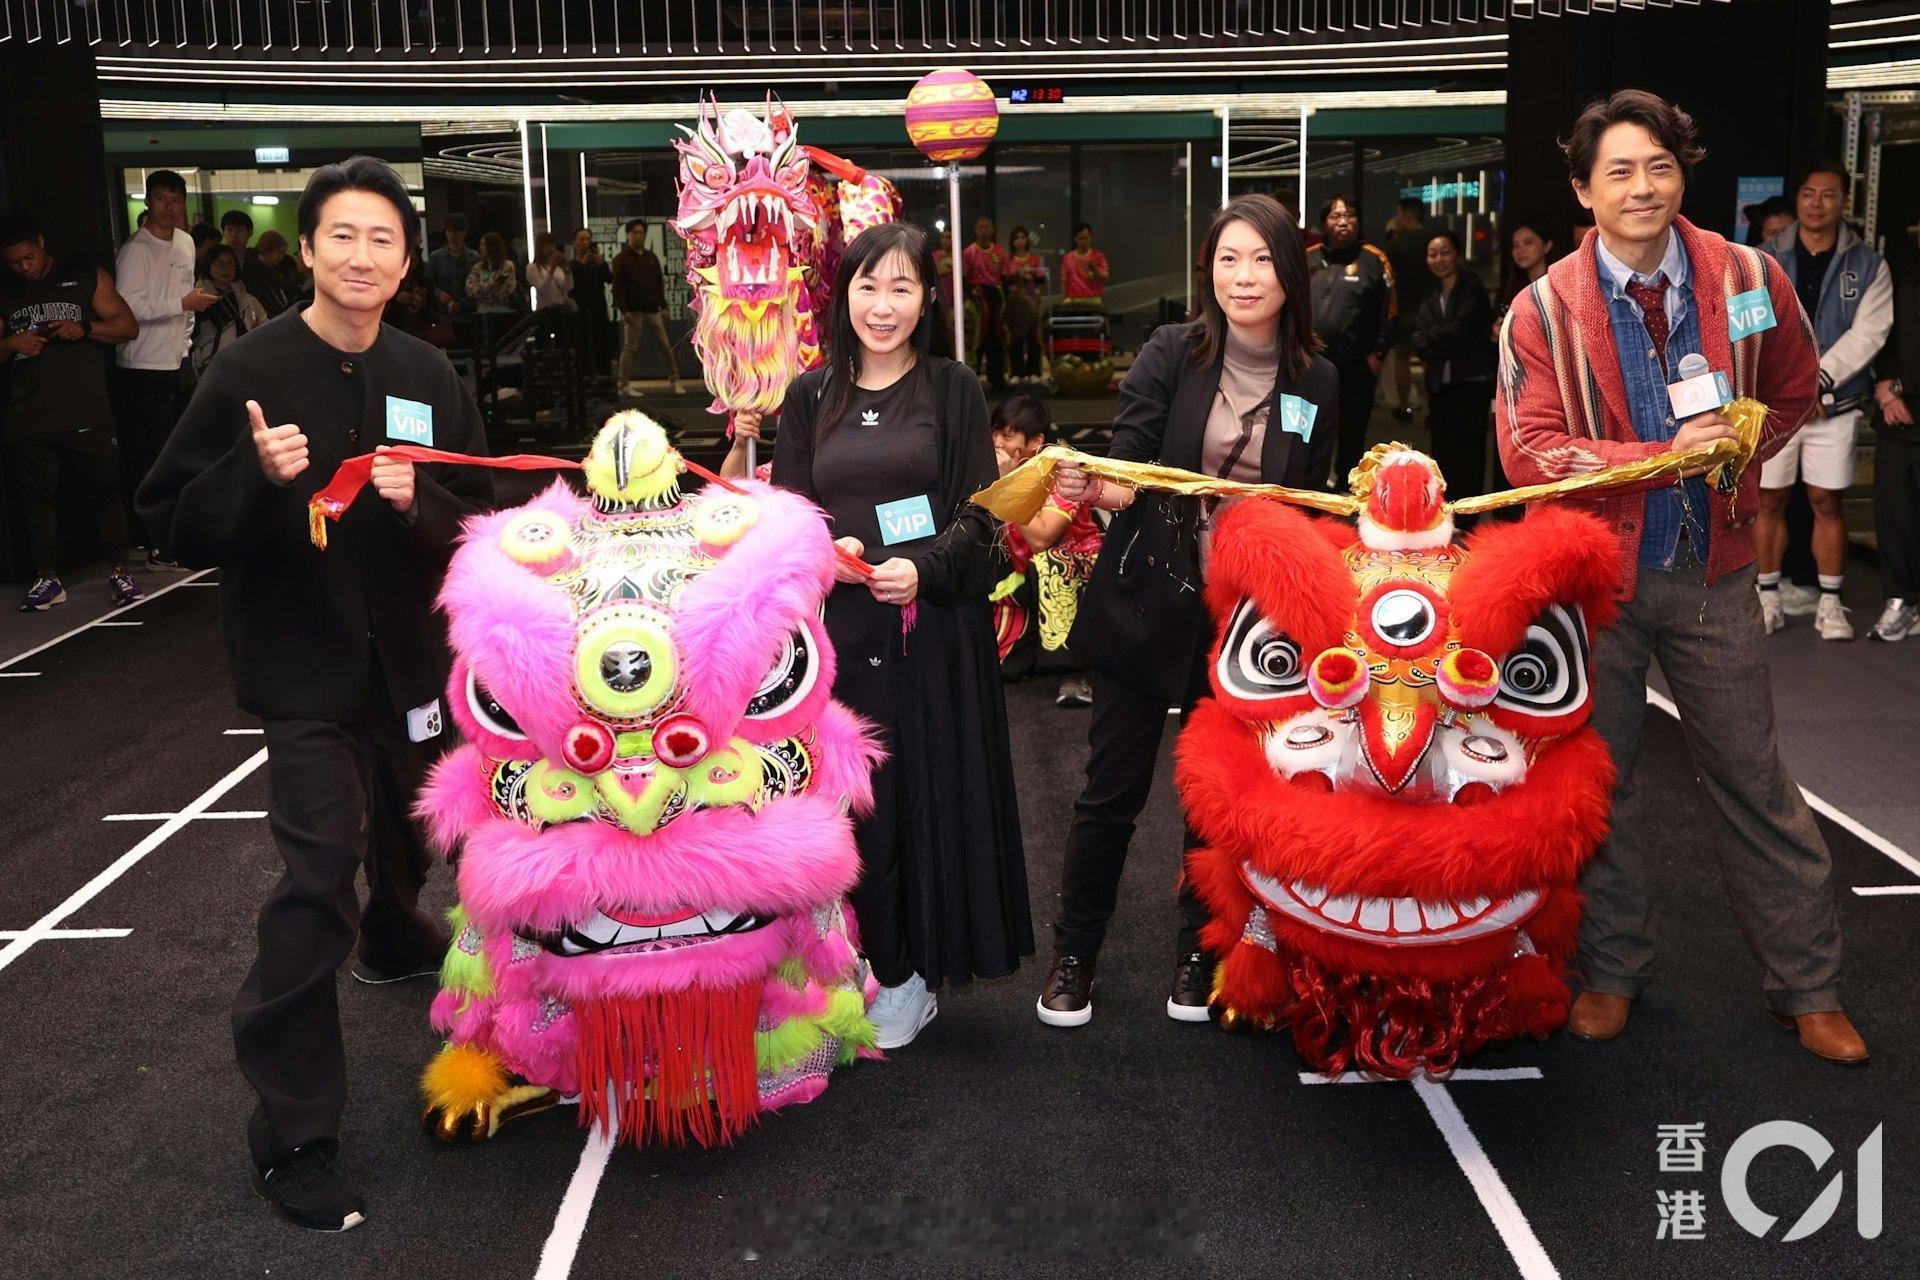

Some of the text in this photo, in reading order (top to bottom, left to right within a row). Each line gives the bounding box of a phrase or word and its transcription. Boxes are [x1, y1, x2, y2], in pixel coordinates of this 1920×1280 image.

[1841, 271, 1858, 299] C
[1729, 305, 1768, 331] VIP
[392, 414, 428, 437] VIP
[1286, 409, 1308, 430] VP
[885, 512, 928, 537] VIP
